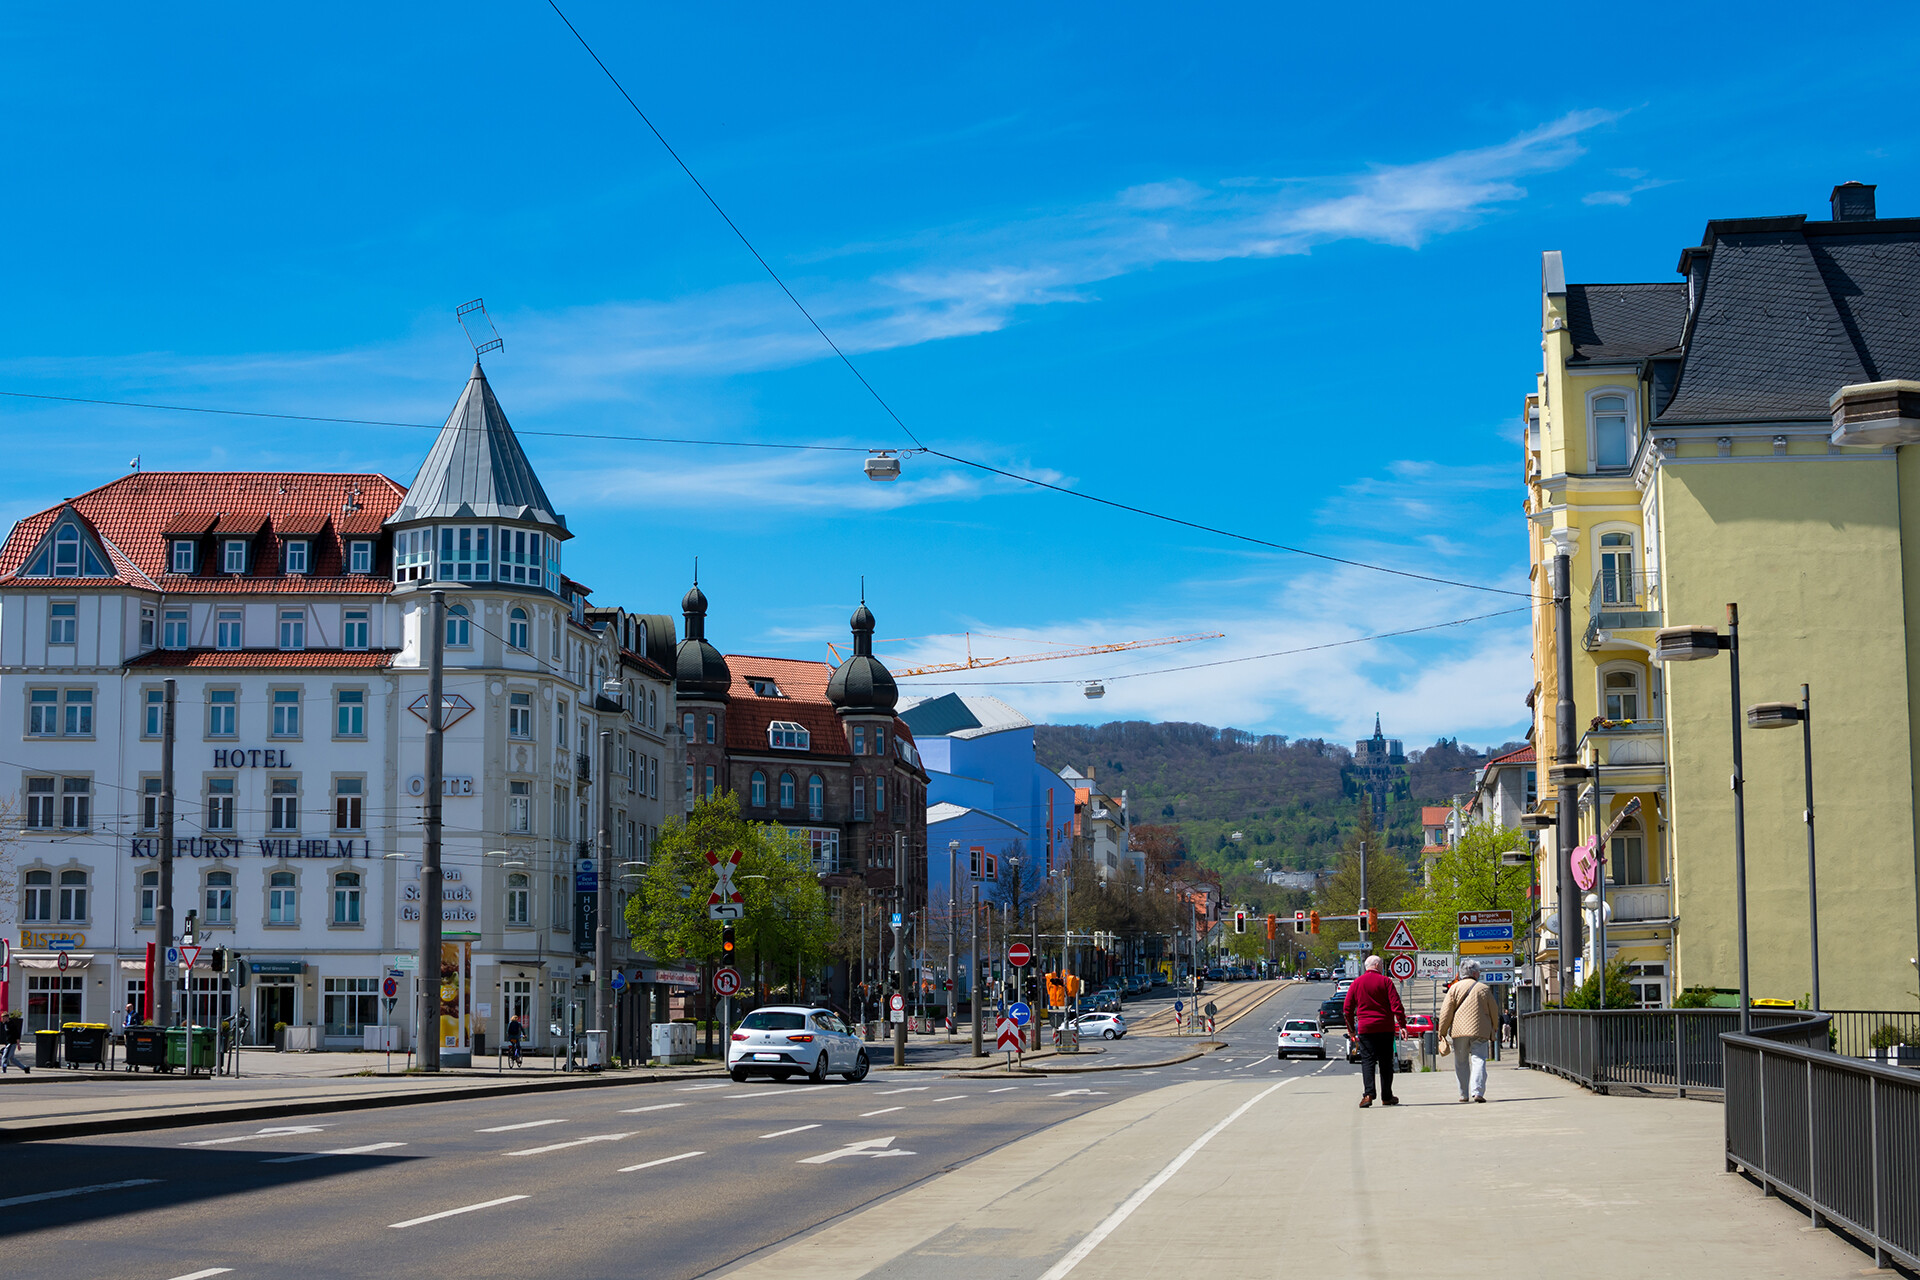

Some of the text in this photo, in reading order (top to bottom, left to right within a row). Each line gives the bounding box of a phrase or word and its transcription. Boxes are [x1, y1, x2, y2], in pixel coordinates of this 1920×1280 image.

[213, 749, 292, 768] HOTEL
[407, 776, 473, 797] OTE
[130, 837, 370, 859] KUFÜRST WILHELM I
[405, 885, 472, 900] Scuck
[401, 906, 477, 921] Geenke
[583, 896, 591, 939] HOTEL
[894, 914, 901, 922] W
[185, 920, 192, 932] H
[1396, 961, 1410, 973] 30
[1422, 957, 1448, 967] Kassel
